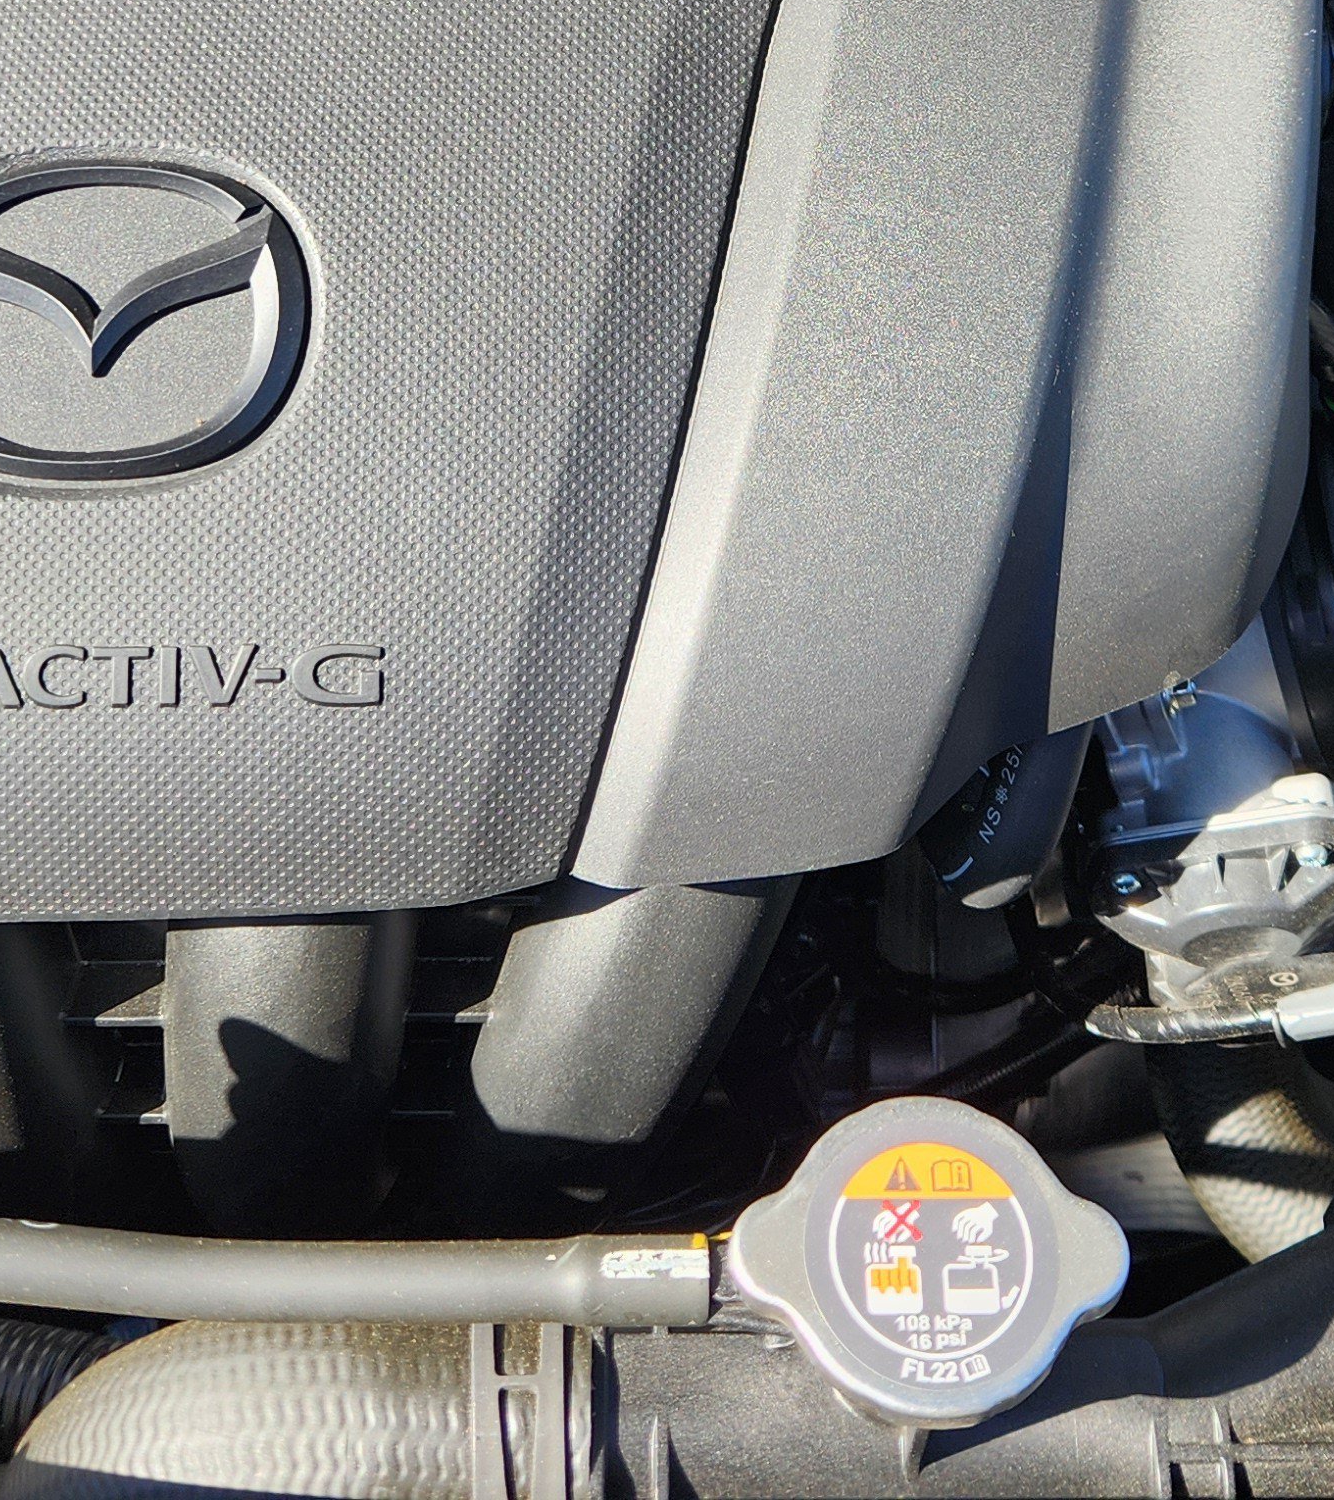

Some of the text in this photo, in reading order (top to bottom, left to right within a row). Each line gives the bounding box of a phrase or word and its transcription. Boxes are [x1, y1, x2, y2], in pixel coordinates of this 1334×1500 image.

[893, 1314, 973, 1332] 108 kPa
[906, 1328, 968, 1350] 16 psi
[900, 1356, 960, 1384] FL22
